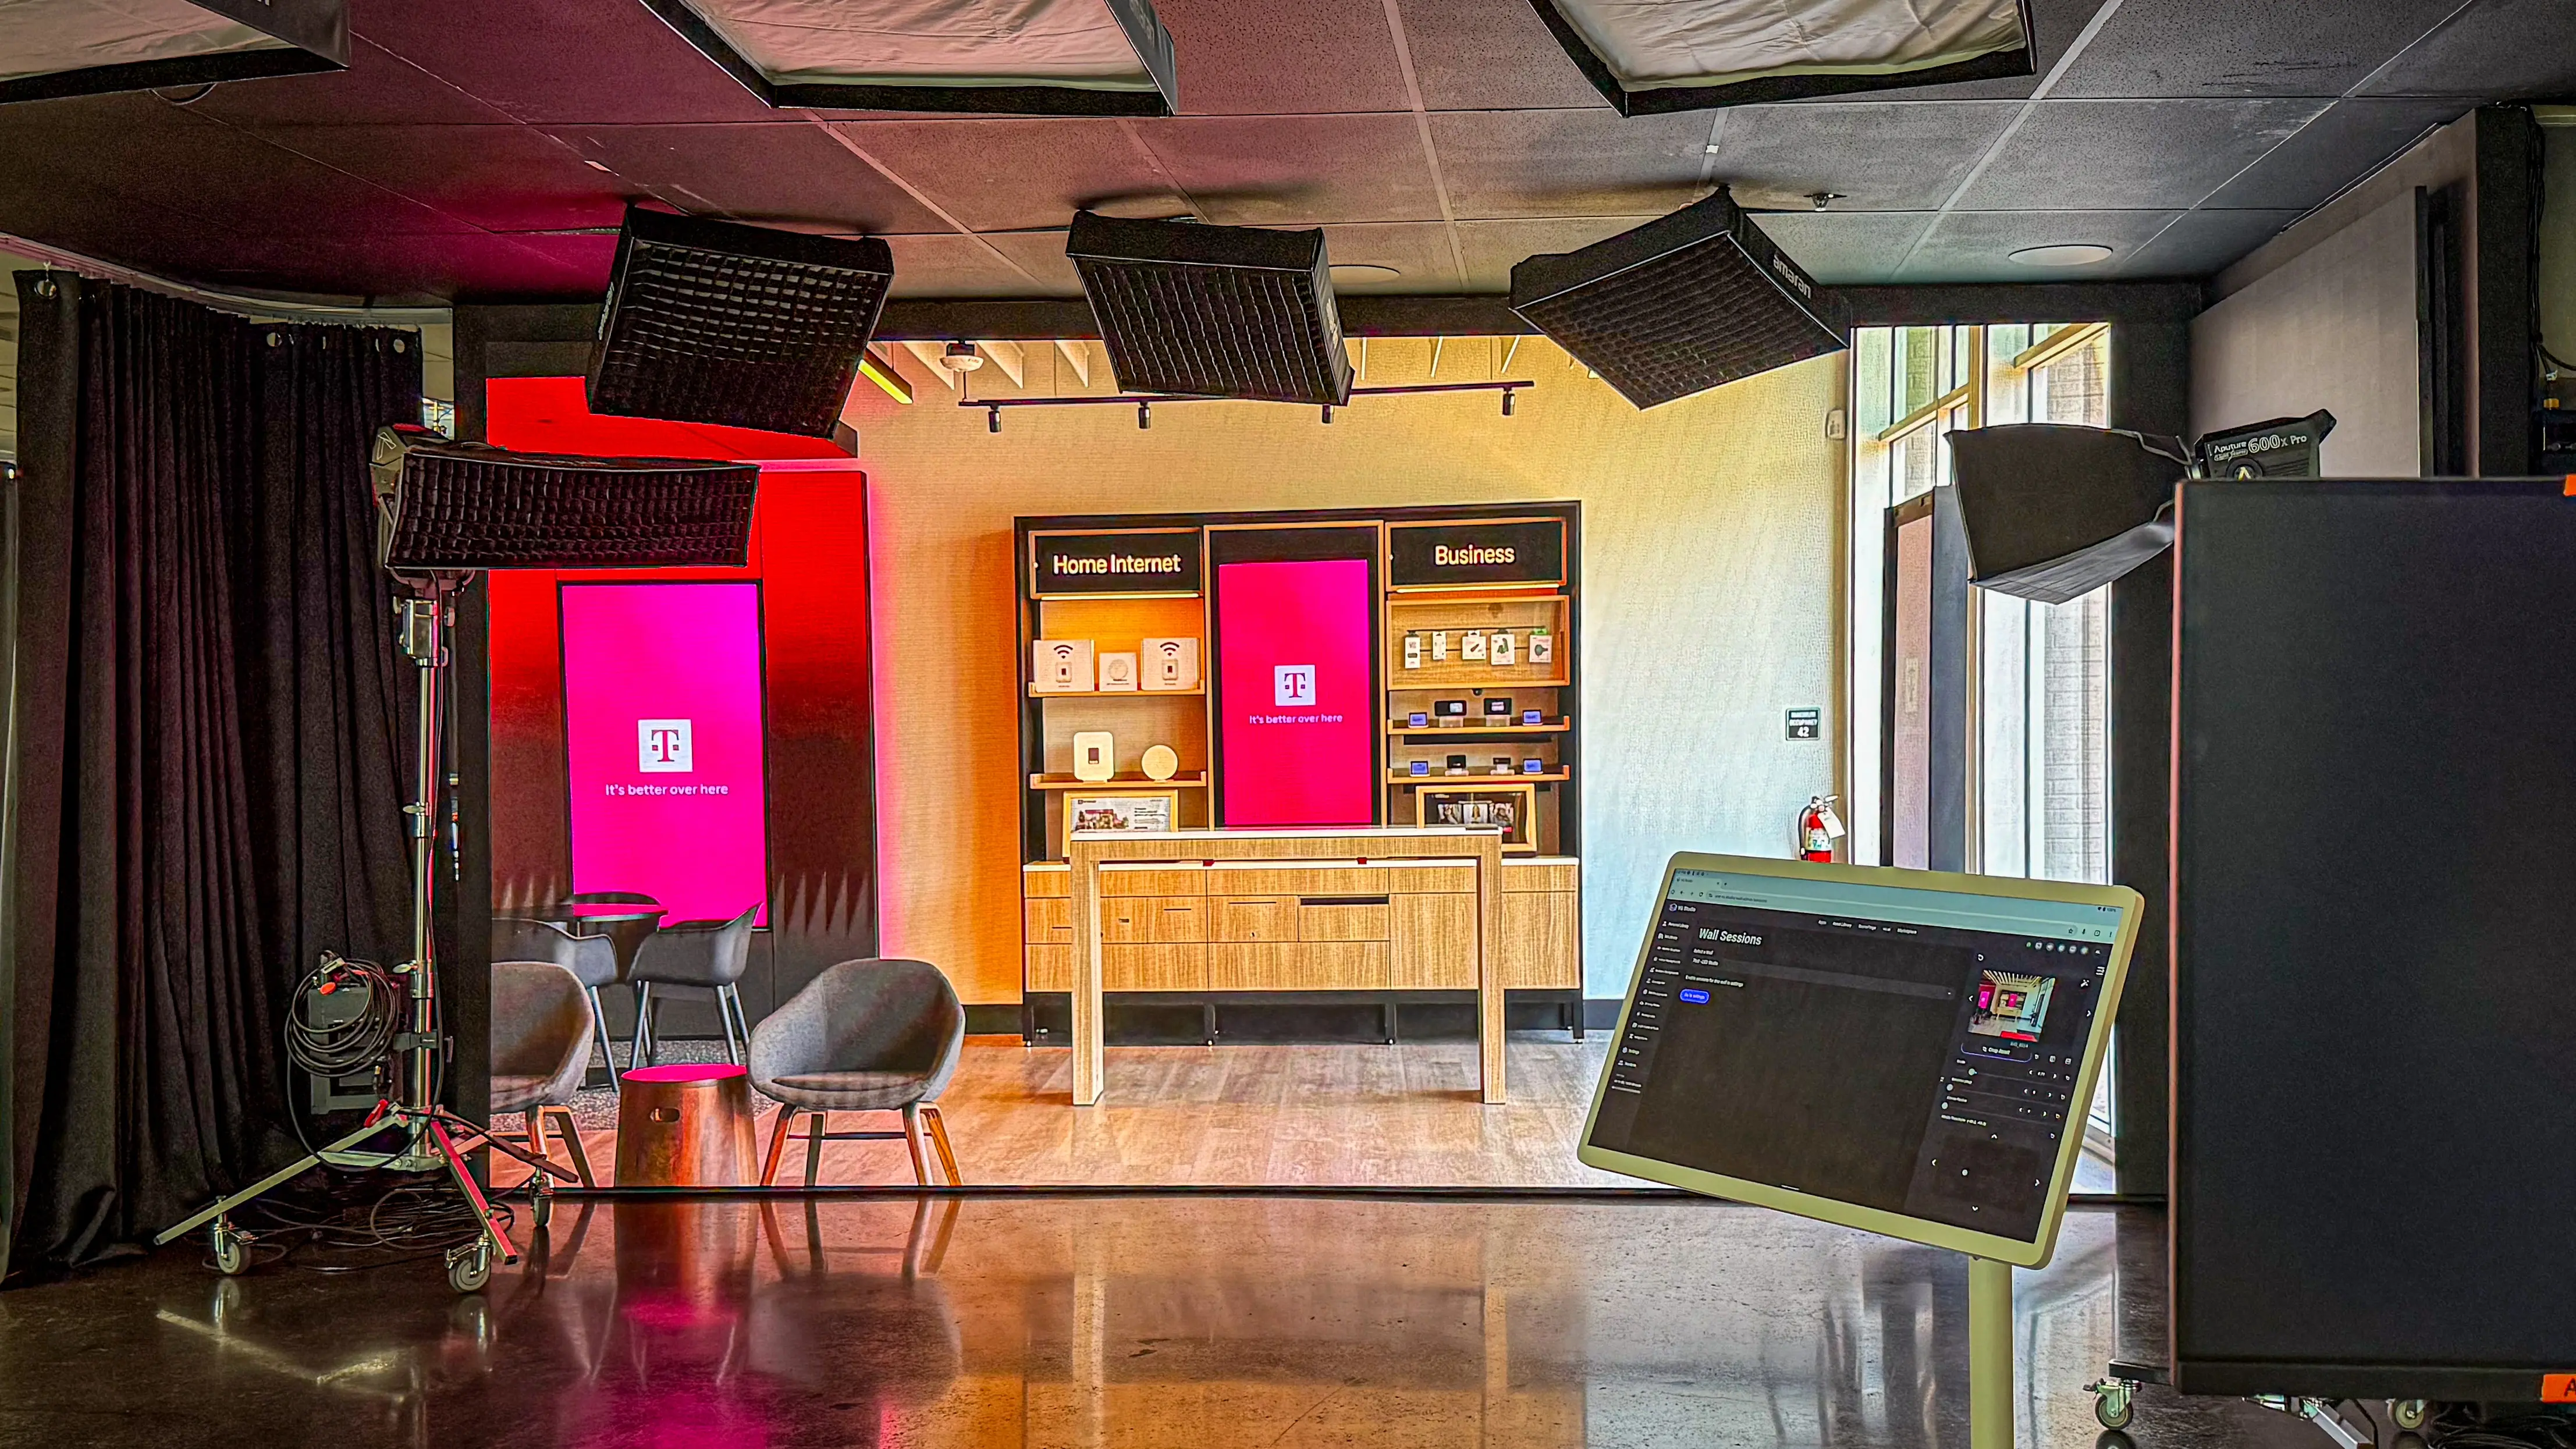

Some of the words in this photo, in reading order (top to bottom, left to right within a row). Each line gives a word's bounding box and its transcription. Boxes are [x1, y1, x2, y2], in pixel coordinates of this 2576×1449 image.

[1773, 254, 1811, 300] amaran
[2213, 441, 2247, 454] Aputure
[2290, 435, 2307, 445] Pro
[1053, 555, 1108, 574] Home
[1110, 553, 1181, 573] Internet
[1435, 544, 1515, 566] Business
[1249, 715, 1264, 724] It's
[1266, 715, 1297, 724] better
[1298, 715, 1320, 723] over
[1321, 713, 1343, 723] here
[1797, 726, 1810, 737] 42
[605, 784, 626, 795] It's
[627, 784, 668, 795] better
[669, 785, 698, 795] over
[700, 783, 729, 795] here
[1699, 928, 1719, 940] Wall
[1719, 930, 1763, 946] Sessions
